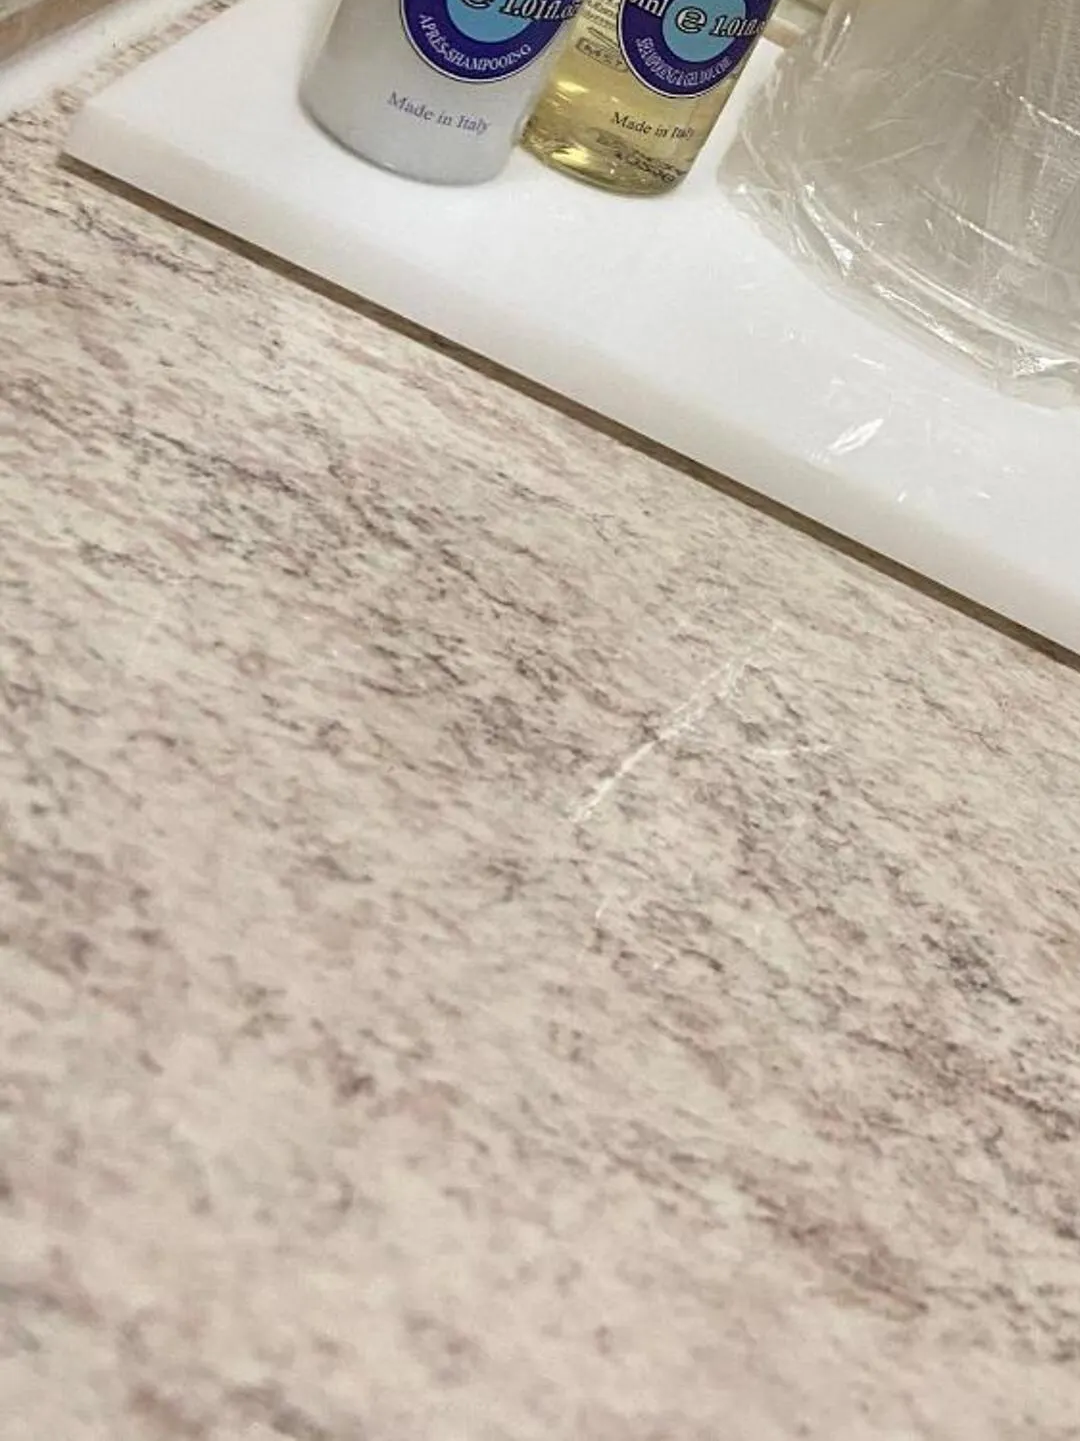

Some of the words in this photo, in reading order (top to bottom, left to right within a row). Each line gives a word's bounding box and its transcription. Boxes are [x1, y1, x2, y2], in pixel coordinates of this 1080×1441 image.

[388, 91, 435, 121] Made
[438, 114, 452, 126] in
[456, 115, 490, 135] Italy
[611, 112, 652, 133] Made
[655, 126, 669, 137] in
